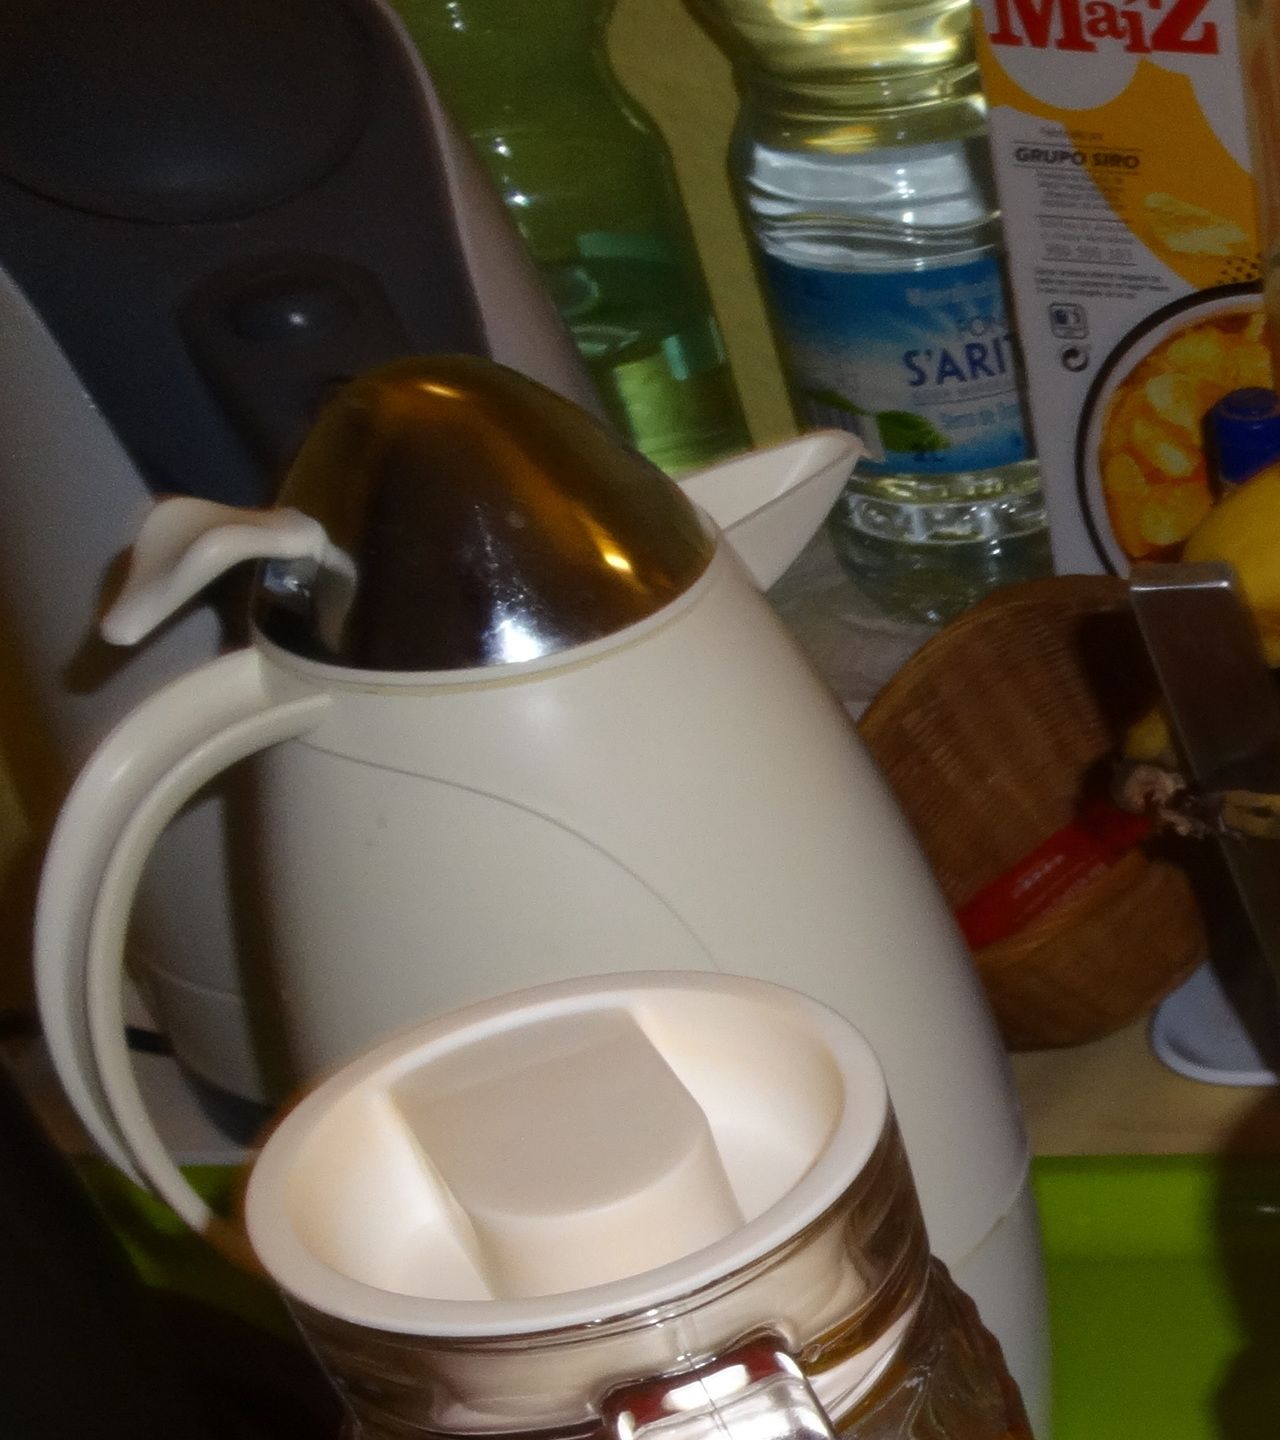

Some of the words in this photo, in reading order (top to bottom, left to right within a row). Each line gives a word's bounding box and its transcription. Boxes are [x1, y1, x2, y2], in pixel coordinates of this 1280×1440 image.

[1015, 147, 1087, 166] GRUPO
[1092, 151, 1140, 169] SIRO
[902, 333, 1011, 387] S'ARI
